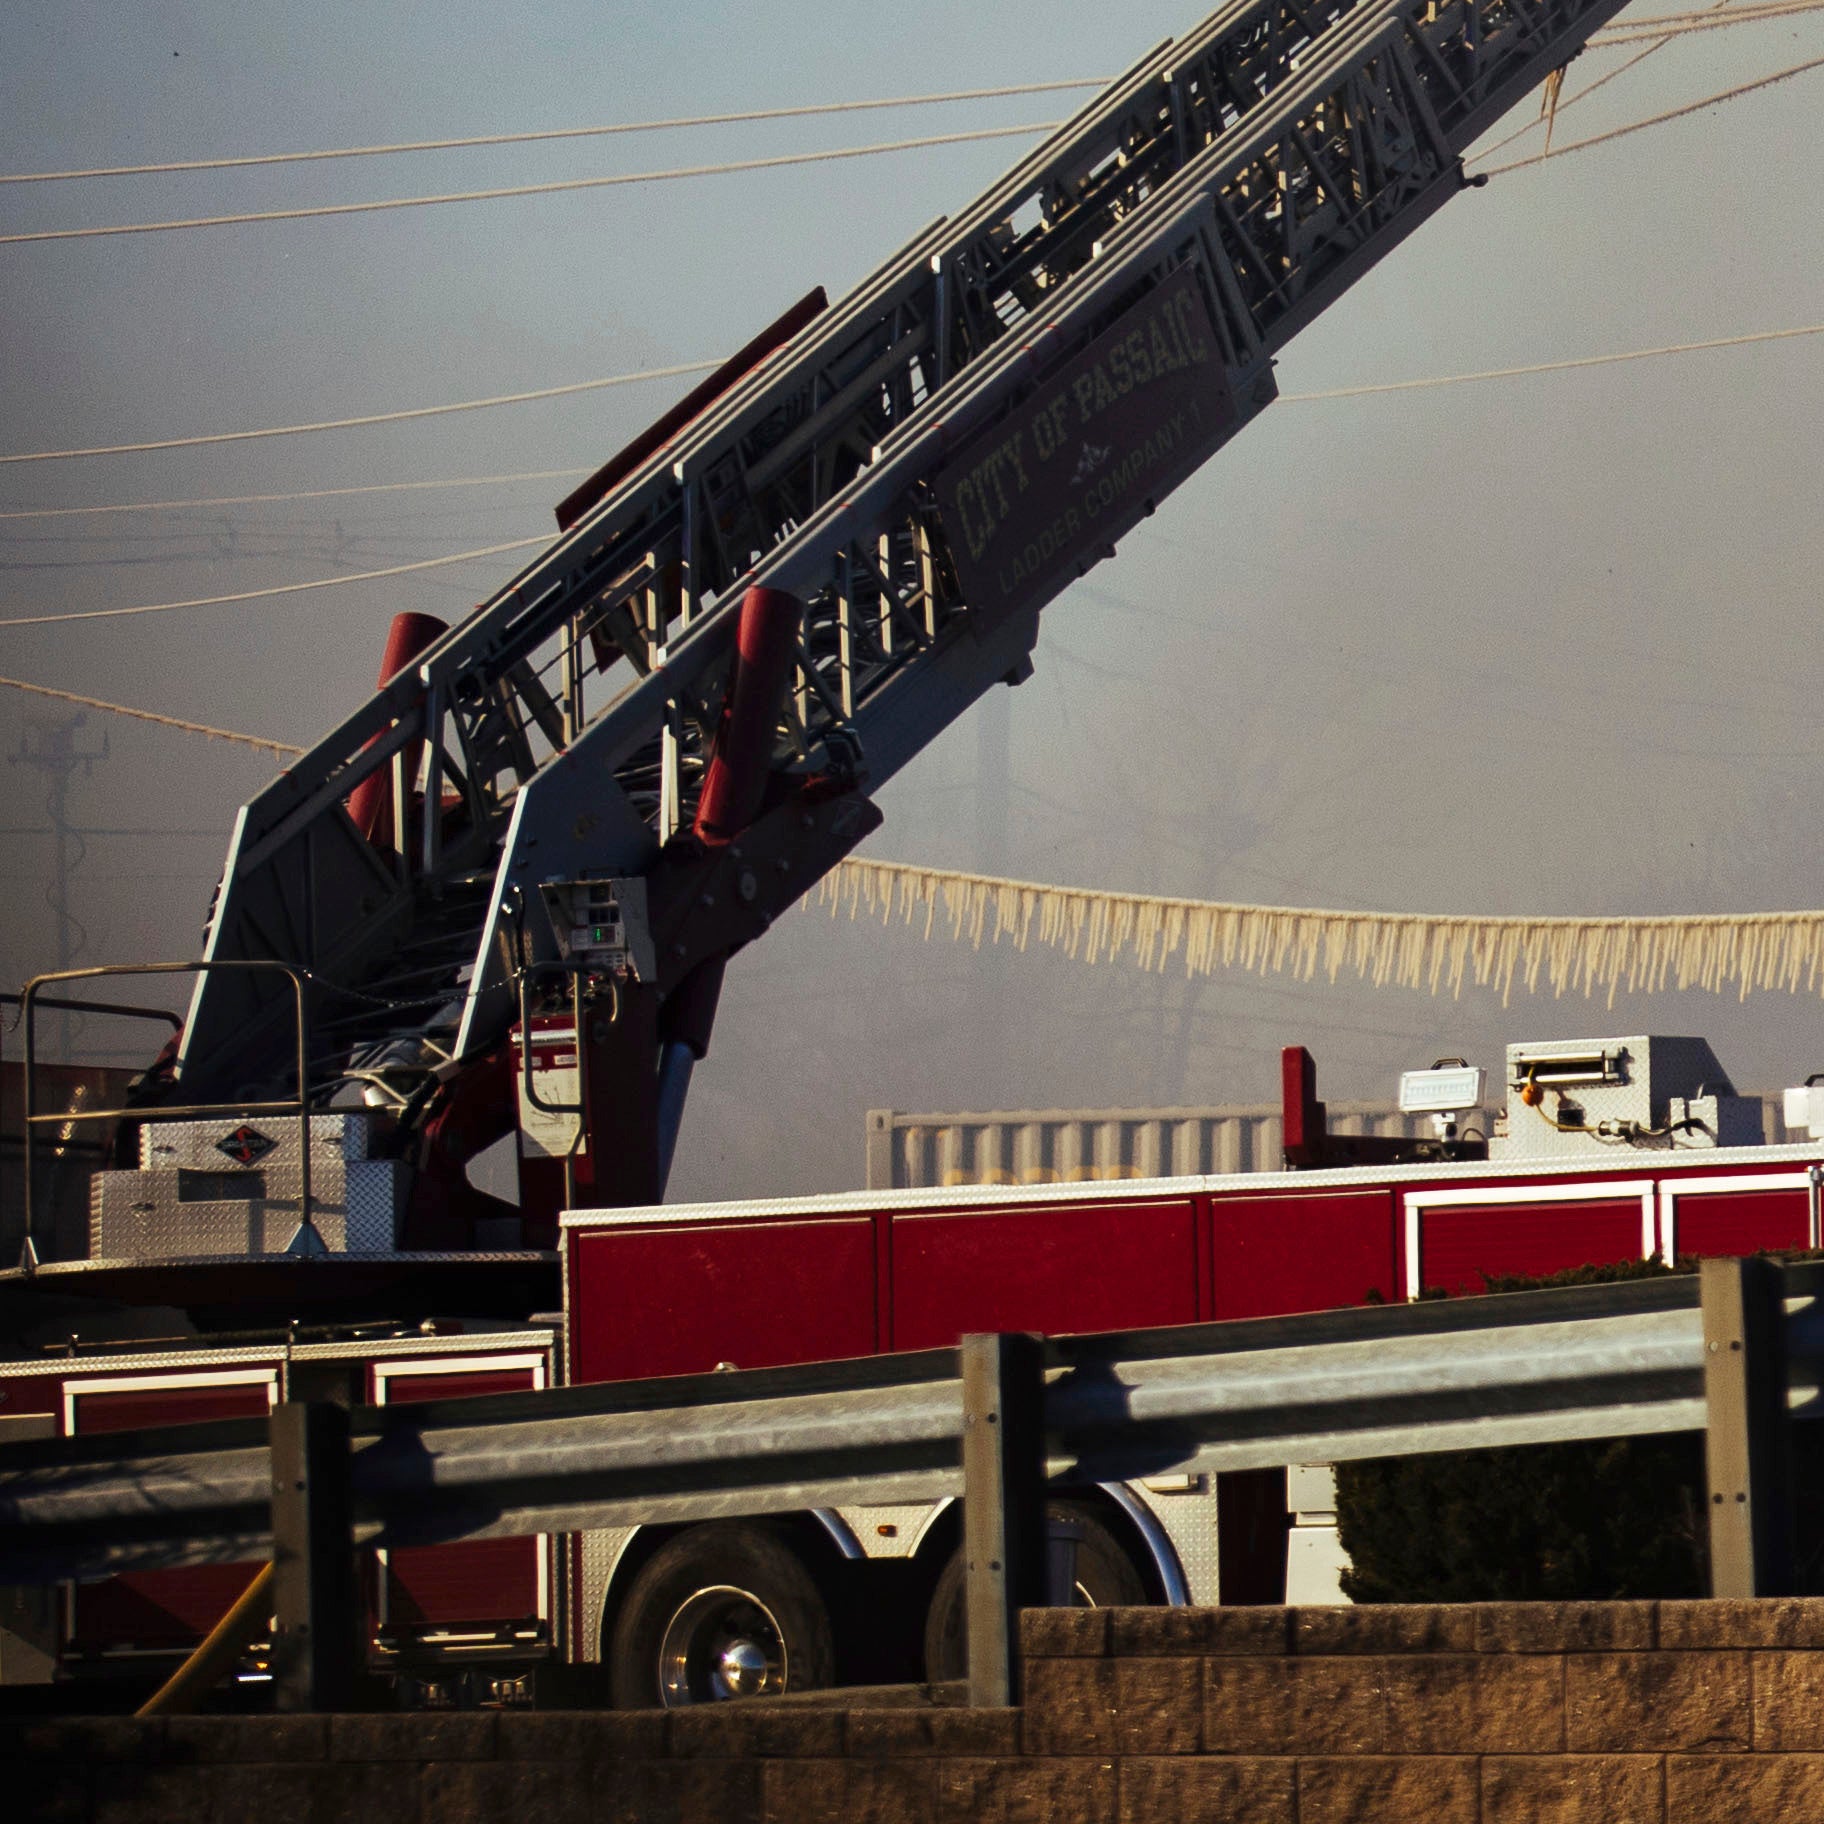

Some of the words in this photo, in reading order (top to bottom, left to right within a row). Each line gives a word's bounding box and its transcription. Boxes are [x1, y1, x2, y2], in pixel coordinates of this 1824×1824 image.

[957, 432, 1029, 558] CITY
[1033, 392, 1068, 461] OF
[1072, 287, 1209, 423] PASSAIC
[999, 509, 1081, 594] LADDER
[1084, 411, 1187, 517] COMPANY
